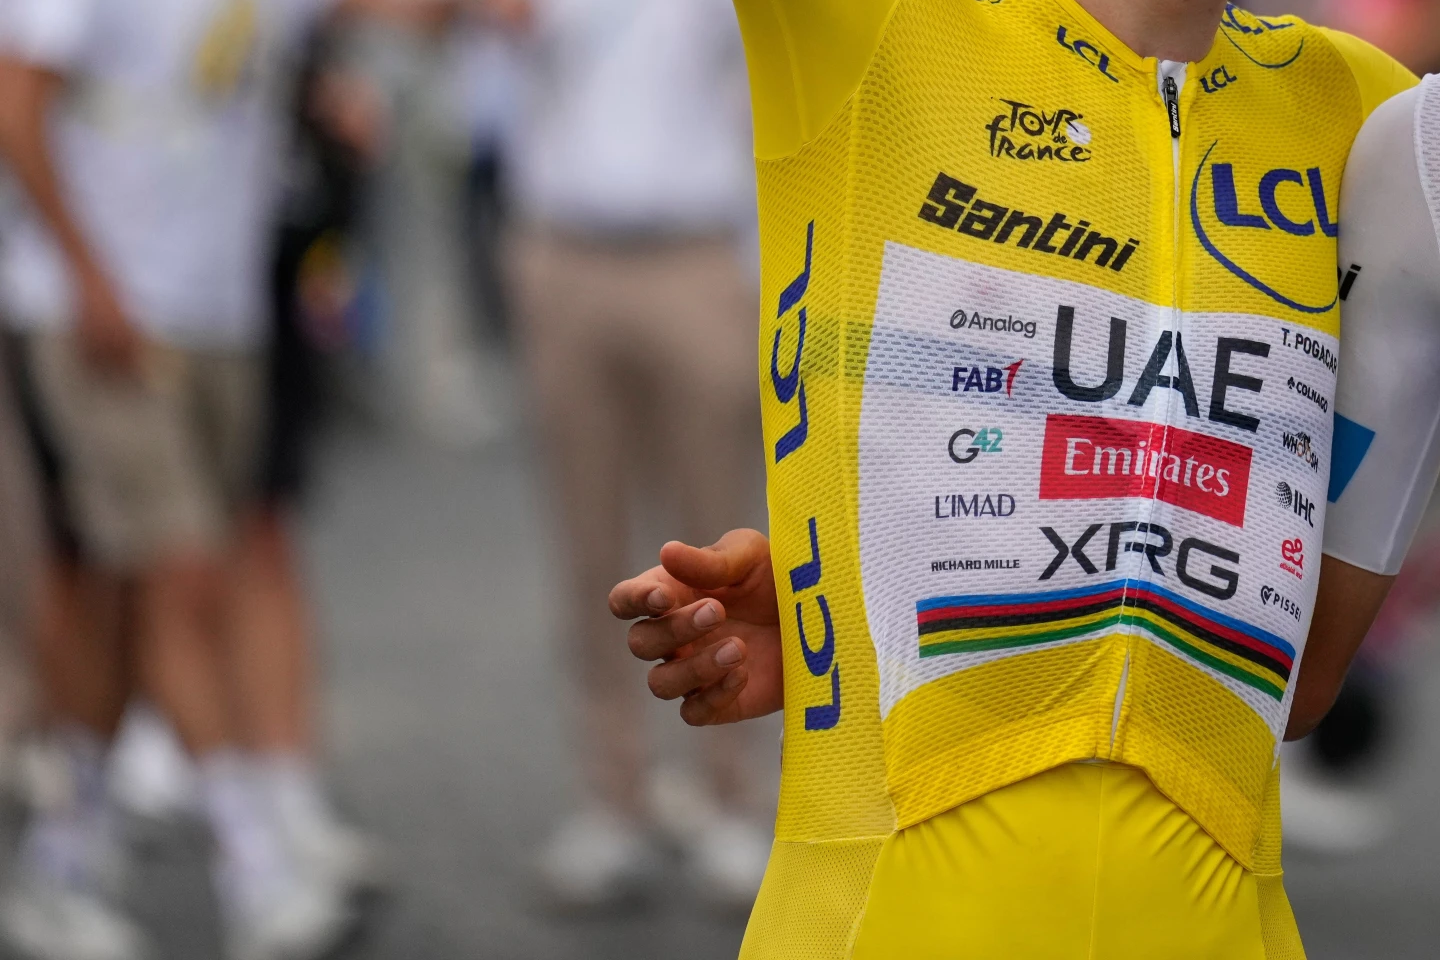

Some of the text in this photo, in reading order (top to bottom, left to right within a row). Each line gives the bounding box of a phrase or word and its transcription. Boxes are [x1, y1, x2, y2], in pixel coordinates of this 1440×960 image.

[1057, 25, 1119, 83] LCL
[1199, 65, 1238, 94] LCL
[1169, 103, 1180, 133] Santini
[918, 171, 1140, 272] Santini
[1211, 163, 1338, 237] LCL
[771, 219, 815, 465] LCL
[968, 311, 1037, 339] Analog
[1281, 327, 1291, 348] T.
[1052, 305, 1271, 433] UAE
[1295, 381, 1328, 413] COLNAGO
[1064, 437, 1231, 497] Emirates
[935, 493, 1016, 519] L'IMAD
[1293, 489, 1315, 528] IHC
[931, 559, 1020, 572] RICHARD MILLE
[1038, 521, 1240, 600] XRG
[789, 517, 841, 730] LCL
